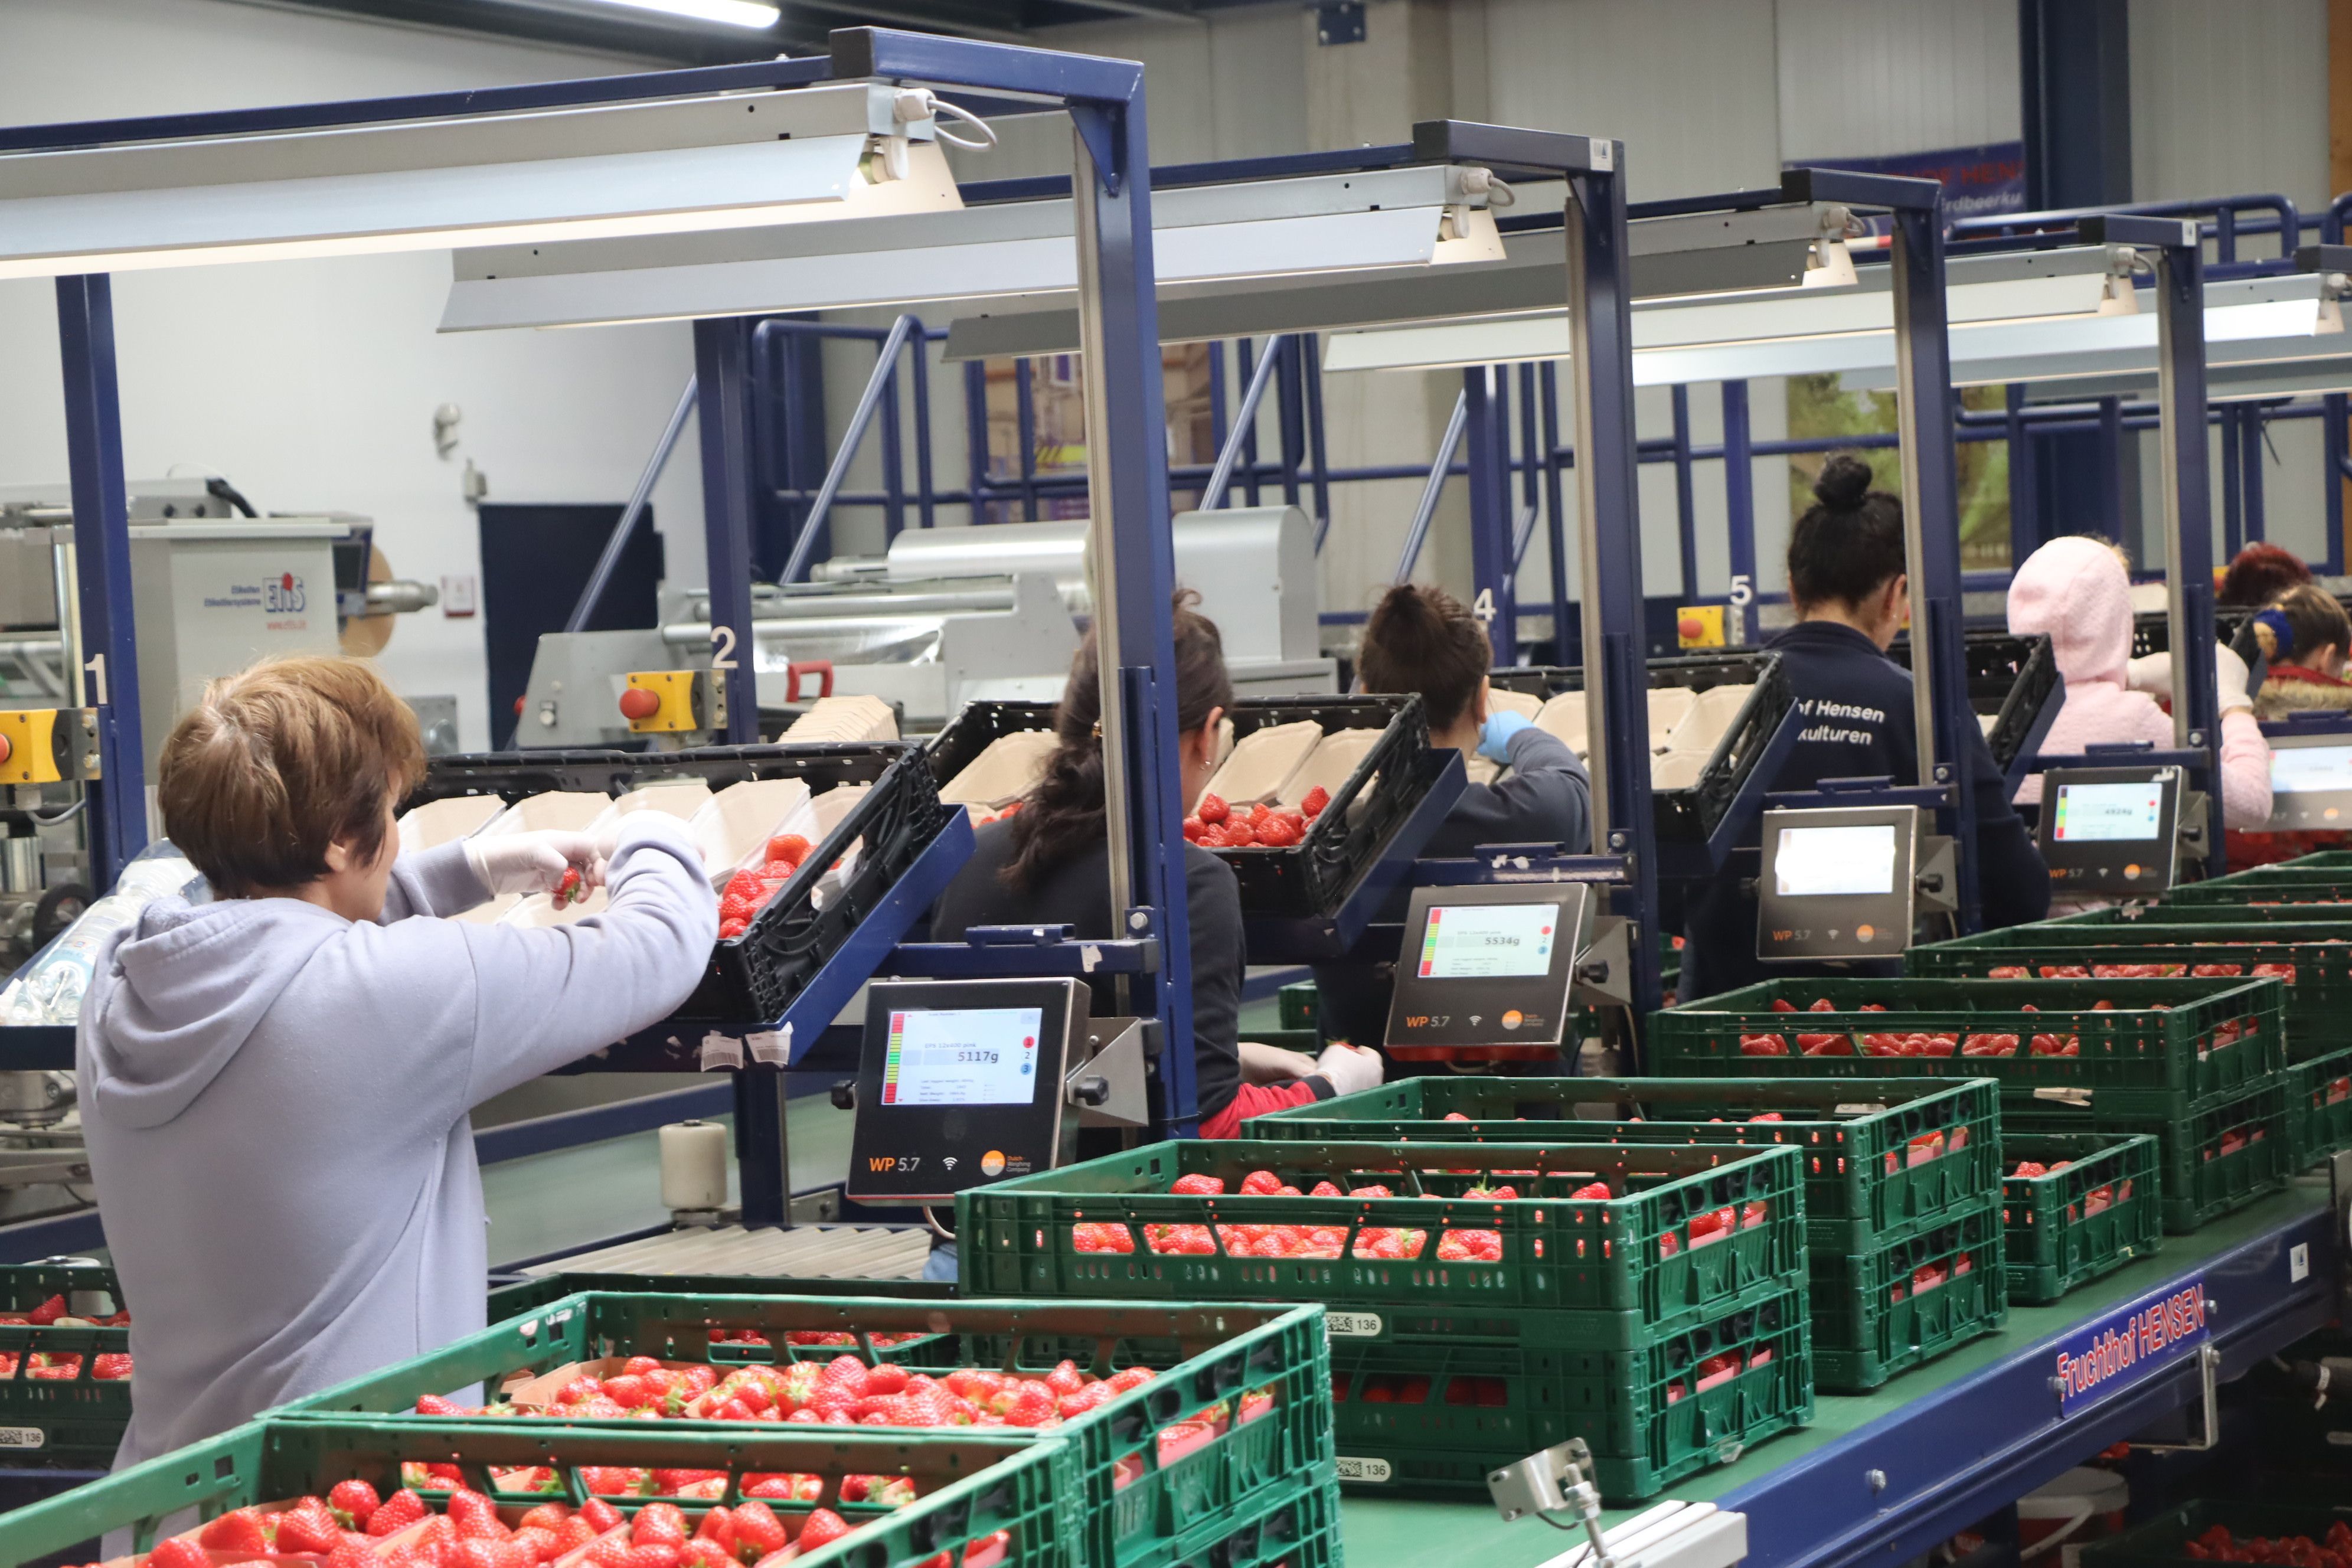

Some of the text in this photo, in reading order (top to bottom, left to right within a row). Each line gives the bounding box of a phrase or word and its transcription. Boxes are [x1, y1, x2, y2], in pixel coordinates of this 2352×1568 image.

[1730, 575, 1752, 606] 5
[1474, 588, 1497, 622] 4
[710, 626, 739, 668] 2
[84, 653, 107, 704] 1
[1816, 700, 1885, 723] Hensen
[1485, 936, 1520, 946] 5534g
[1772, 930, 1792, 940] WP
[1406, 1015, 1450, 1028] WP 5.7
[958, 1051, 999, 1064] 5117g
[869, 1157, 921, 1172] WP 5.7
[1357, 1319, 1377, 1330] 136
[2057, 1282, 2204, 1403] Fruchthof HENSEN
[25, 1432, 41, 1442] 136
[1366, 1464, 1386, 1476] 136
